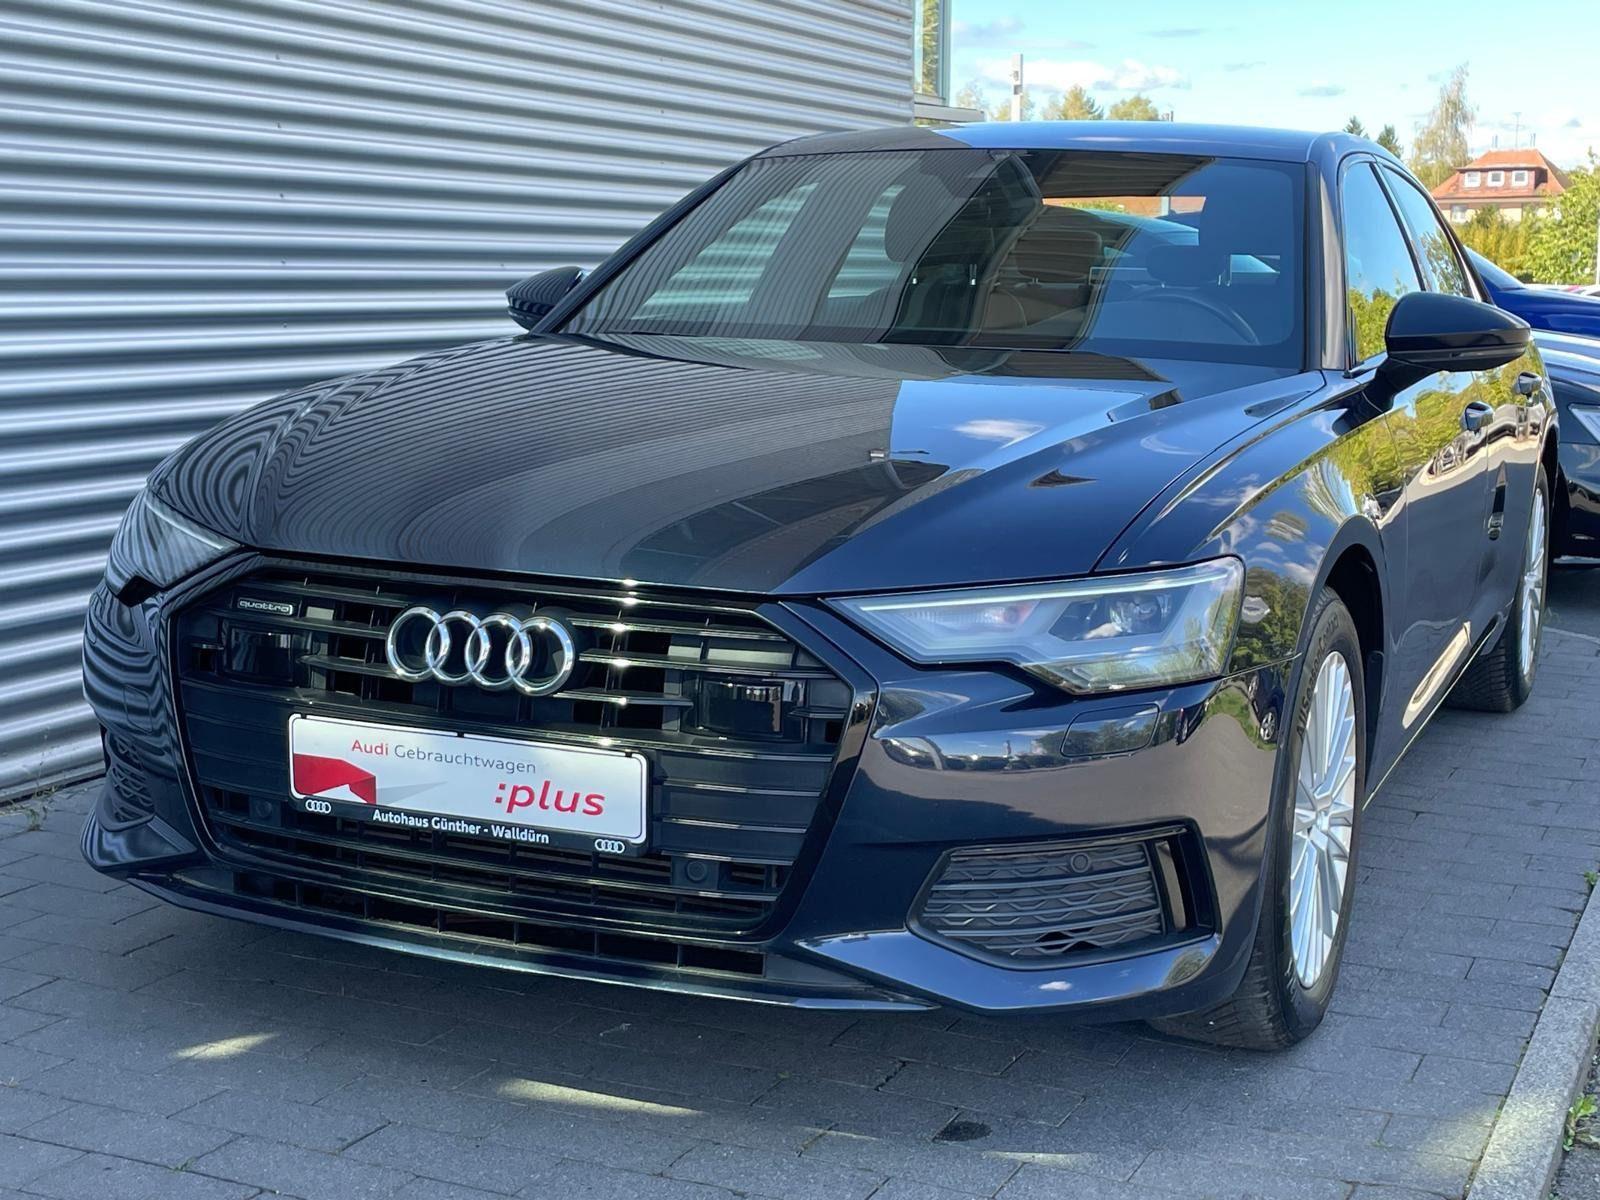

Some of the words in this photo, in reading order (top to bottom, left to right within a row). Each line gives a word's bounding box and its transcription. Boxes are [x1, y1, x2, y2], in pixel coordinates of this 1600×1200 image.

[240, 600, 290, 612] quattro
[351, 739, 389, 756] Audi
[394, 744, 536, 774] Gebrauchtwagen
[495, 780, 606, 816] :plus
[372, 809, 429, 828] Autohaus
[431, 816, 482, 835] Günther
[491, 824, 550, 844] Walldürn
